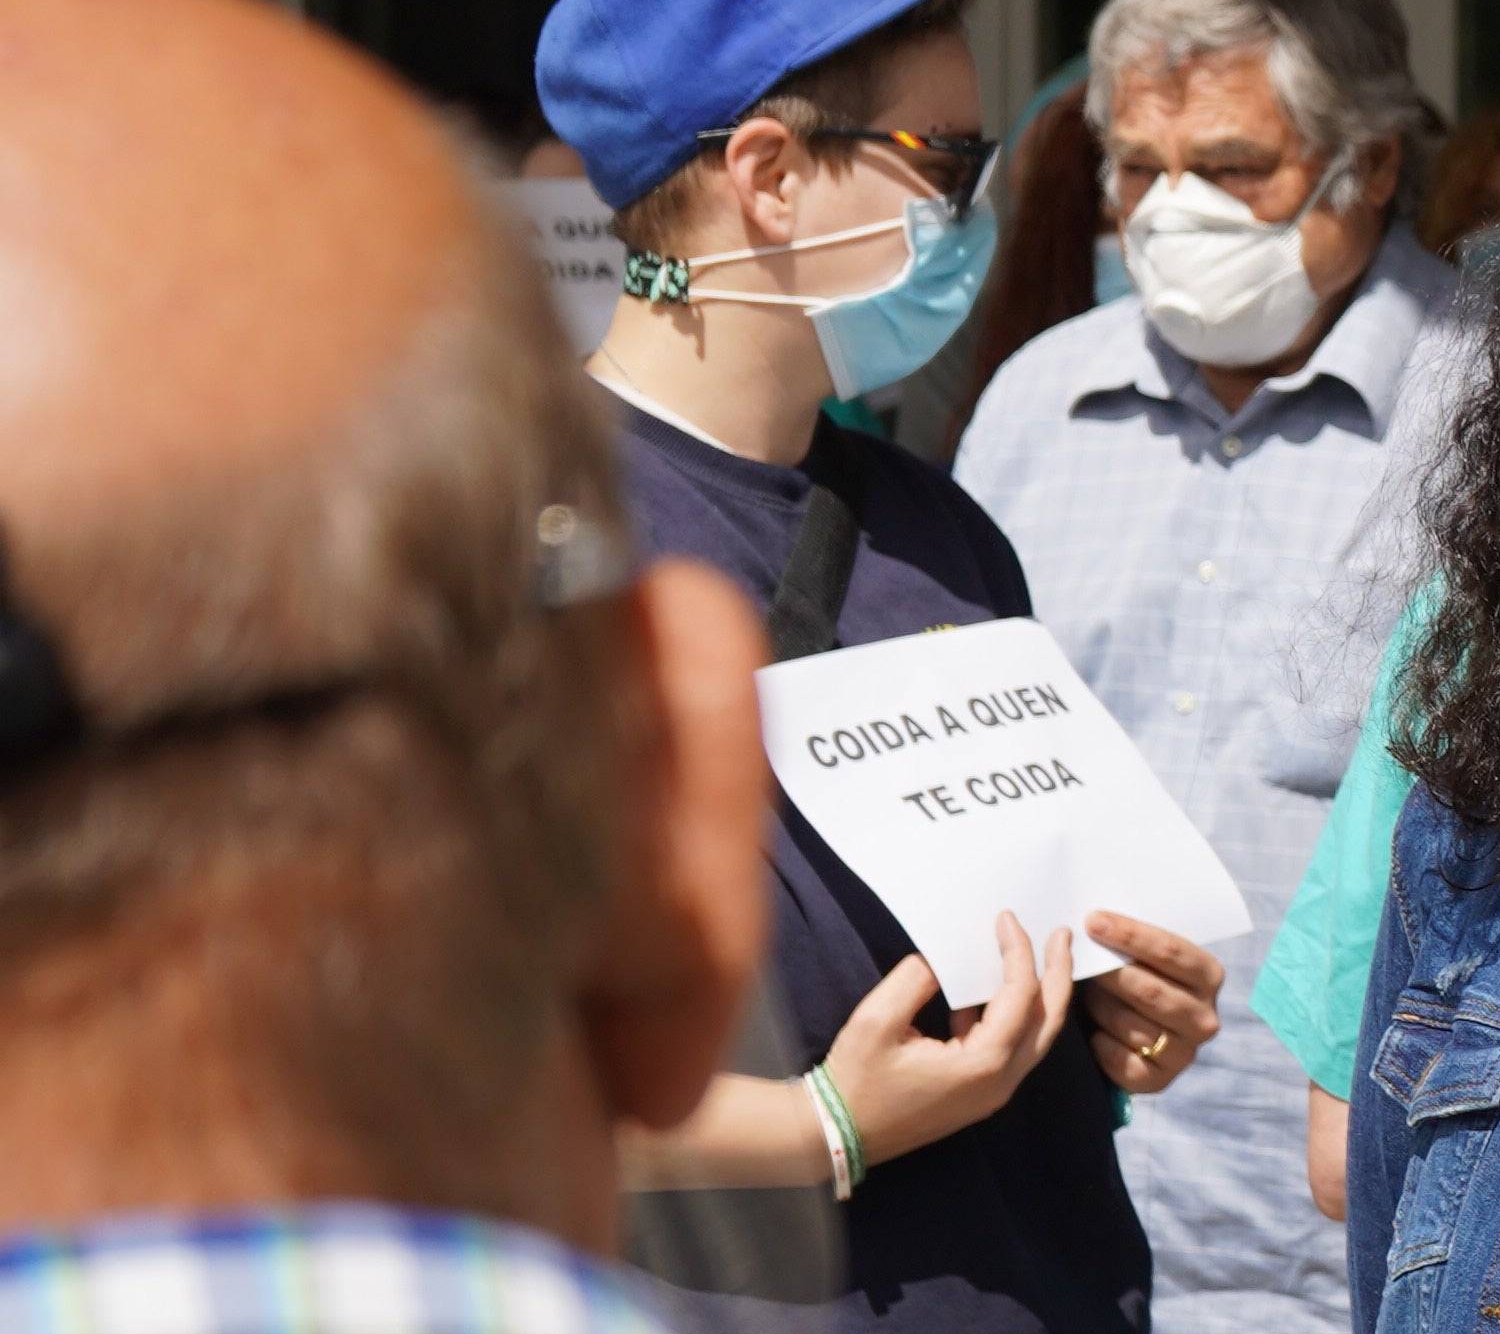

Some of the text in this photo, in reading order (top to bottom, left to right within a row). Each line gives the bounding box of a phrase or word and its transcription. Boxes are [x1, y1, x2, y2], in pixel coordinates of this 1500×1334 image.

[807, 684, 1070, 768] COIDA A QUEN
[902, 759, 1084, 821] TE COIDA
